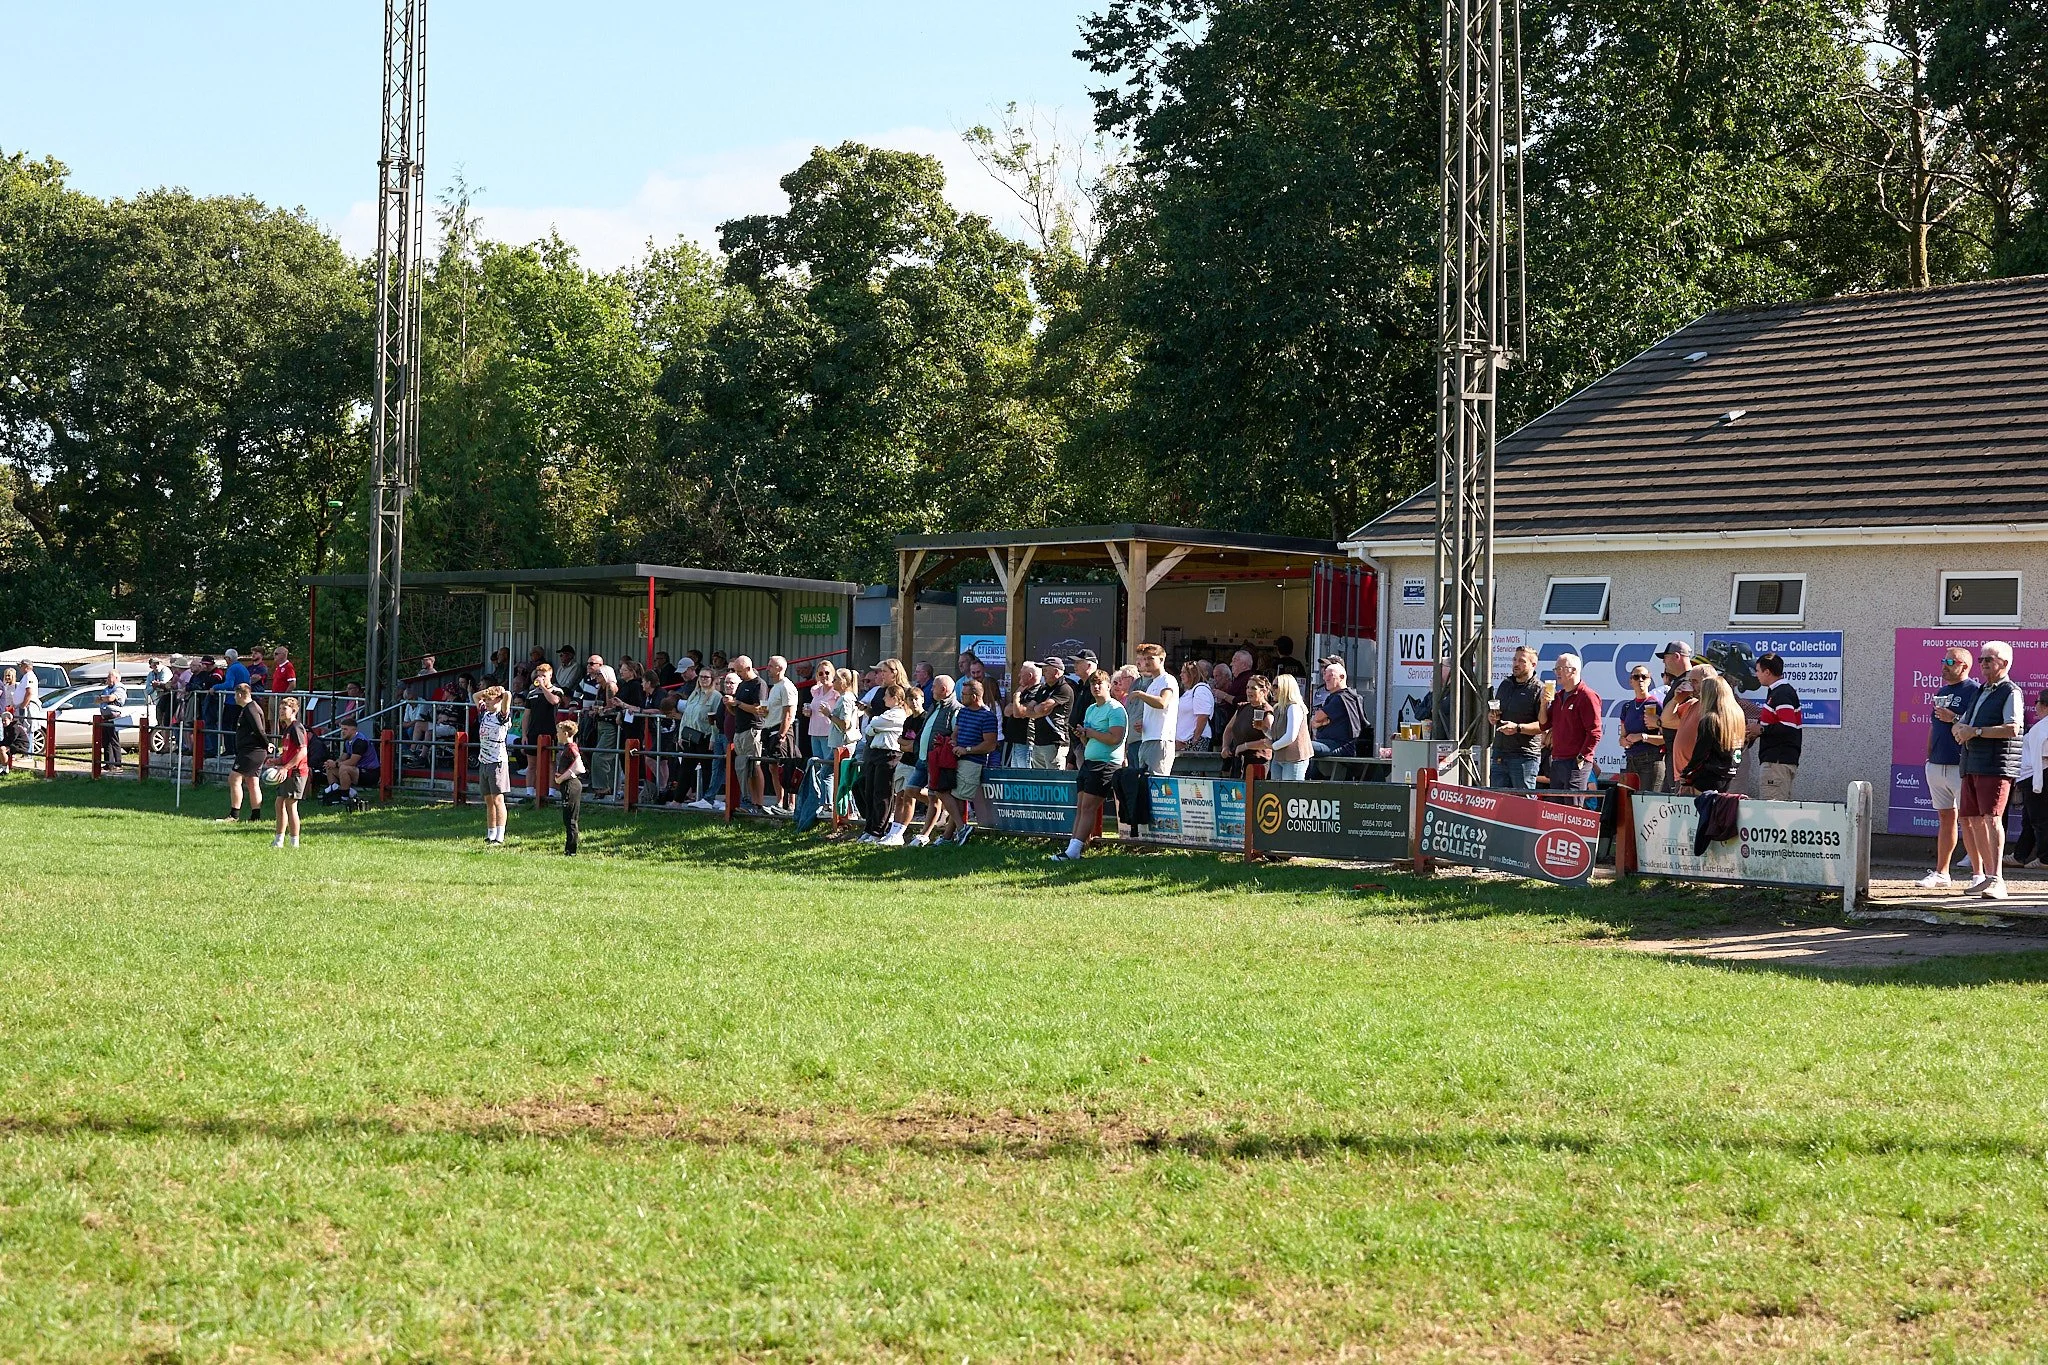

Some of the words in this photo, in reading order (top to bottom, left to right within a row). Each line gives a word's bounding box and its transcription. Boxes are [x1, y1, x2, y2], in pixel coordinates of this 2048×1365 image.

[962, 596, 994, 604] FELINFOEL
[1040, 597, 1074, 605] FELINFOEL
[799, 613, 831, 623] SWANSEA
[101, 623, 131, 631] Toilets
[1399, 633, 1425, 659] WG
[1755, 641, 1769, 652] CB
[1771, 641, 1787, 652] Car
[1789, 641, 1837, 652] Collection
[1922, 639, 1944, 647] PROUD
[1945, 640, 1979, 648] SPONSORS
[985, 646, 1000, 655] LEWIS
[1808, 662, 1824, 670] Today
[1808, 671, 1838, 681] 233207
[1798, 687, 1816, 695] Starting
[1599, 755, 1606, 764] of
[1439, 789, 1464, 805] 01554
[1465, 793, 1497, 810] 749977
[1286, 798, 1341, 821] GRADE
[1353, 802, 1375, 811] Structural
[1375, 802, 1402, 812] Engineering
[997, 808, 1065, 821] TDW-DISTRIBUTION.CO.UK
[1541, 809, 1564, 823] Llanelli
[1567, 815, 1582, 827] SA15
[1582, 818, 1596, 829] 2DS
[1286, 819, 1341, 834] CONSULTING
[1362, 820, 1374, 828] 01554
[1375, 820, 1384, 828] 707
[1640, 815, 1659, 843] Llys
[1658, 803, 1691, 820] Gwyn
[1347, 828, 1406, 839] www.gradeconsulting.co.uk
[1434, 820, 1469, 840] CLICK
[1469, 829, 1476, 839] &
[1750, 827, 1787, 844] 01792
[1791, 829, 1841, 847] 882353
[1432, 835, 1487, 860] COLLECT
[1546, 837, 1581, 859] LBS
[1750, 847, 1841, 861] llysgwyn1@btconnect.com
[1488, 855, 1531, 869] www.lbsbm.co.uk
[1702, 864, 1716, 873] Care
[1716, 865, 1735, 874] Home
